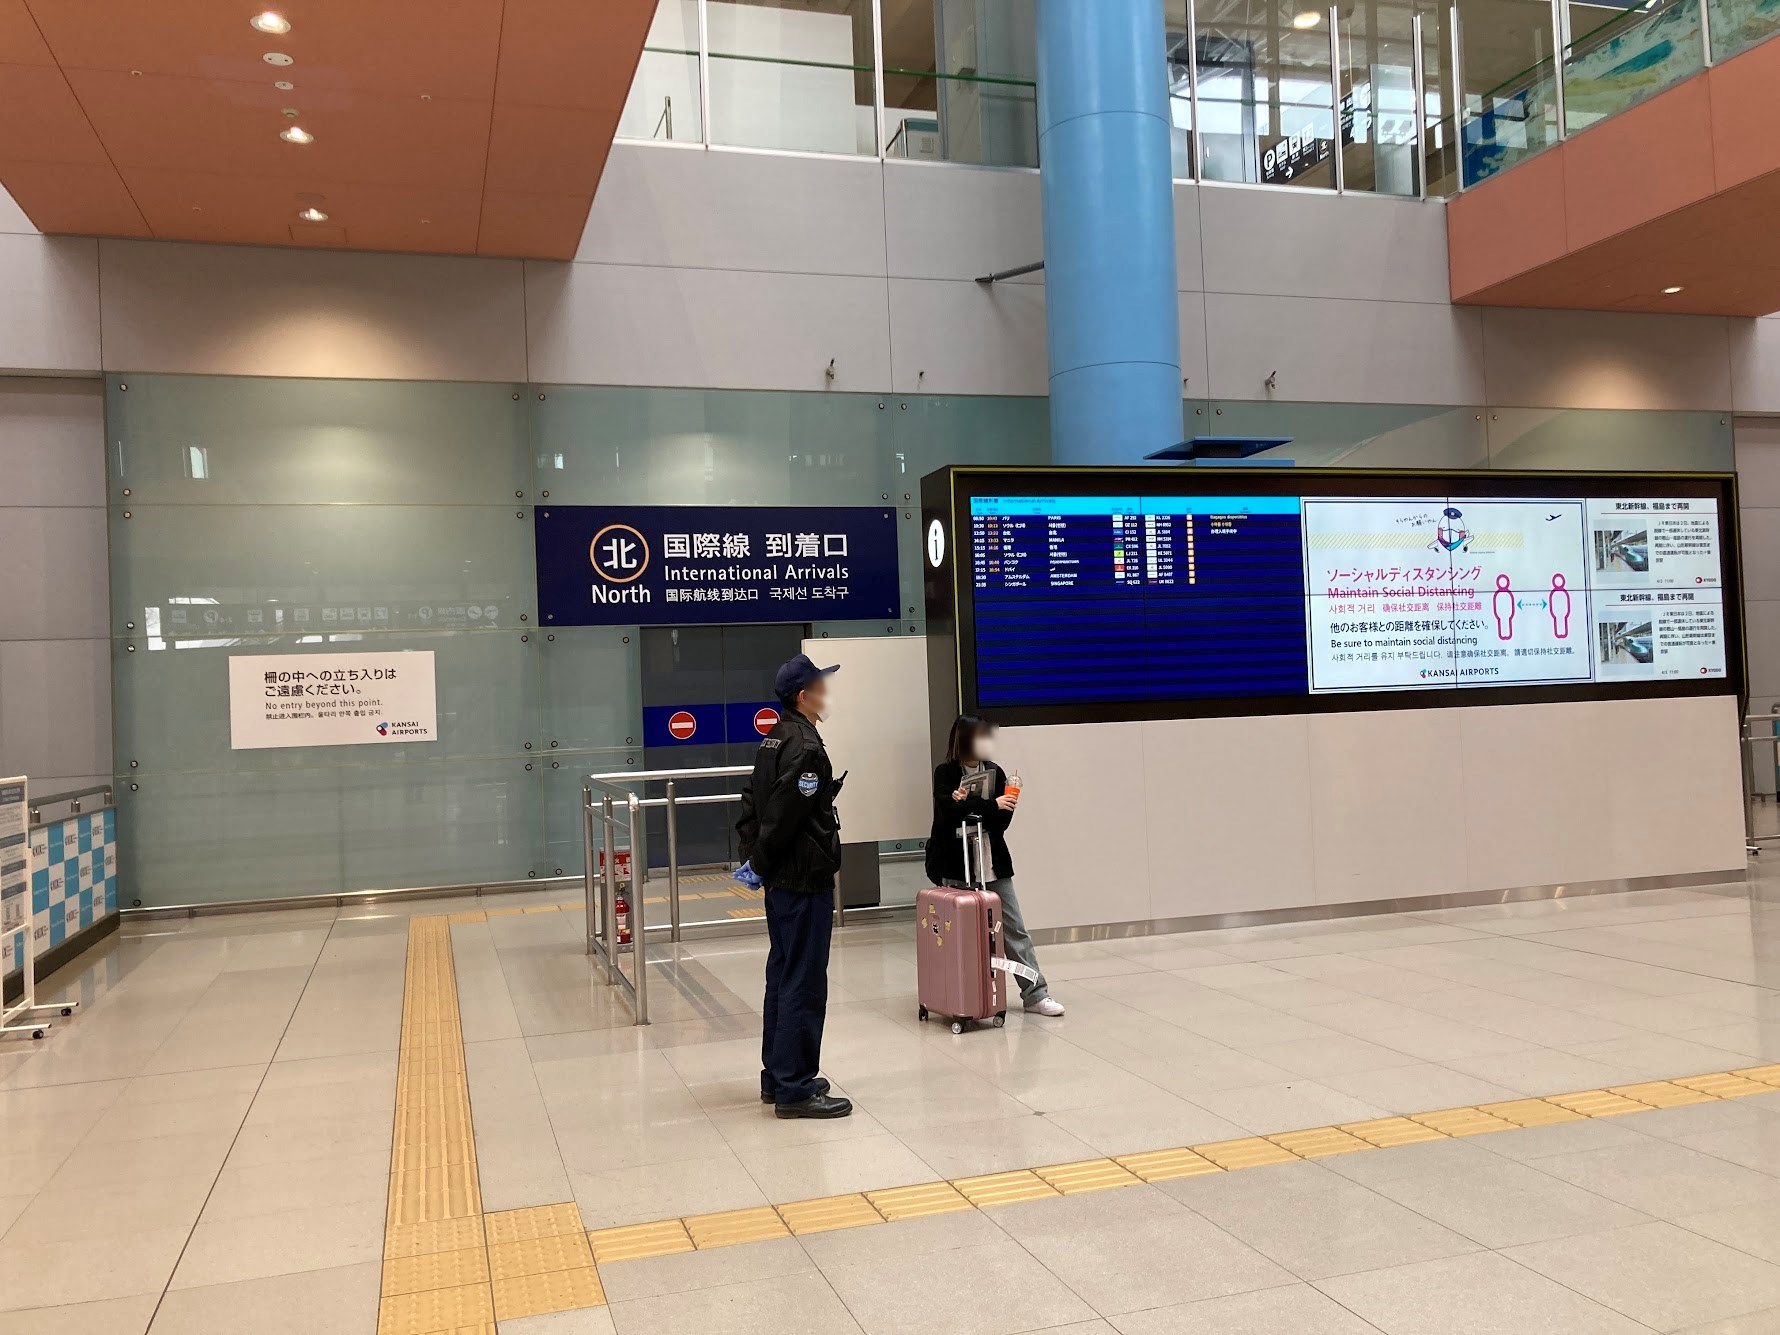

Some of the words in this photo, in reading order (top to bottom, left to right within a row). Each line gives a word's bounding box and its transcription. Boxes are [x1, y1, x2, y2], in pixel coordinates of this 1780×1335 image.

[663, 533, 751, 559] 国際線
[765, 532, 848, 558] 到着口
[602, 538, 638, 569] 北
[665, 564, 777, 581] International
[785, 563, 849, 581] Arrivals
[1327, 566, 1482, 583] ソーシャルディスタンシング
[591, 584, 651, 604] North
[666, 587, 759, 603] 国际航线到达口
[769, 586, 807, 601] 국제선
[811, 586, 850, 600] 도착구
[1327, 586, 1379, 599] Maintain
[1382, 586, 1414, 598] Social
[1418, 585, 1475, 599] Distancing
[1329, 603, 1355, 615] 사회적
[1358, 603, 1375, 614] 거리
[1330, 619, 1489, 634] 他のお客様との距離を確保してください。
[1331, 640, 1342, 648] Be
[1344, 640, 1362, 648] sure
[1364, 640, 1373, 648] to
[1374, 637, 1411, 647] maintain
[1413, 637, 1435, 646] social
[1437, 635, 1478, 646] distancing
[264, 668, 397, 684] 柵の中への立ち入りは
[1459, 667, 1499, 676] AIRPORTS
[264, 683, 362, 698] ご遠慮ください。
[265, 702, 277, 710] No
[280, 701, 303, 711] entry
[305, 700, 337, 710] beyond
[339, 699, 356, 707] this
[358, 699, 383, 708] point.
[391, 728, 428, 736] AIRPORTS
[799, 780, 818, 789] SECURITY
